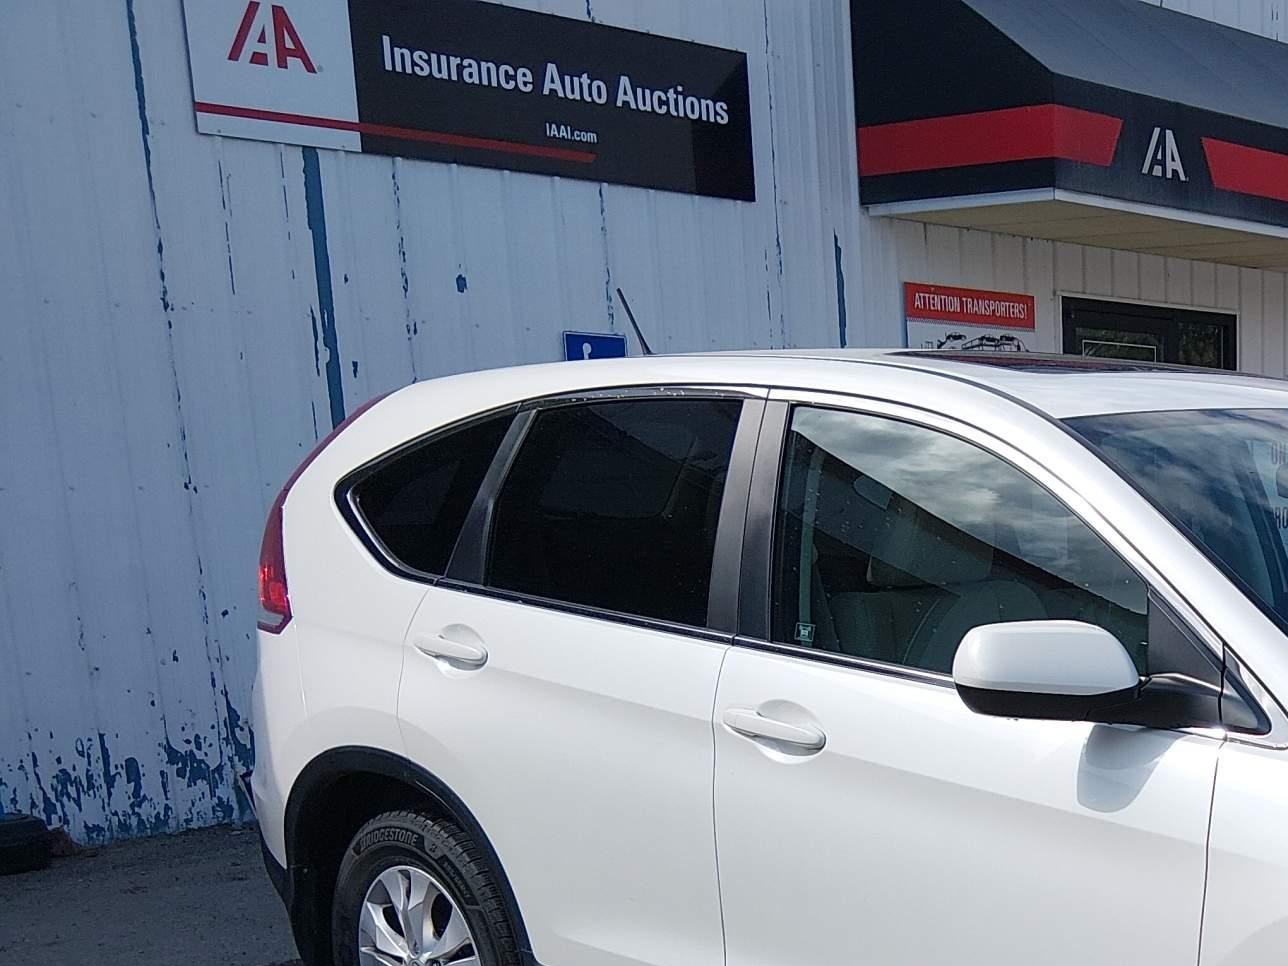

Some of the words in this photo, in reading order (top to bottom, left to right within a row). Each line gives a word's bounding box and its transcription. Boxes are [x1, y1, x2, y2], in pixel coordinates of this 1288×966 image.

[381, 34, 534, 94] Insurance
[542, 62, 608, 105] Auto
[616, 75, 730, 126] Auctions
[545, 121, 598, 145] IAAI.com
[913, 291, 961, 314] ATTENTION
[961, 297, 1029, 321] TRANSPORTERS!
